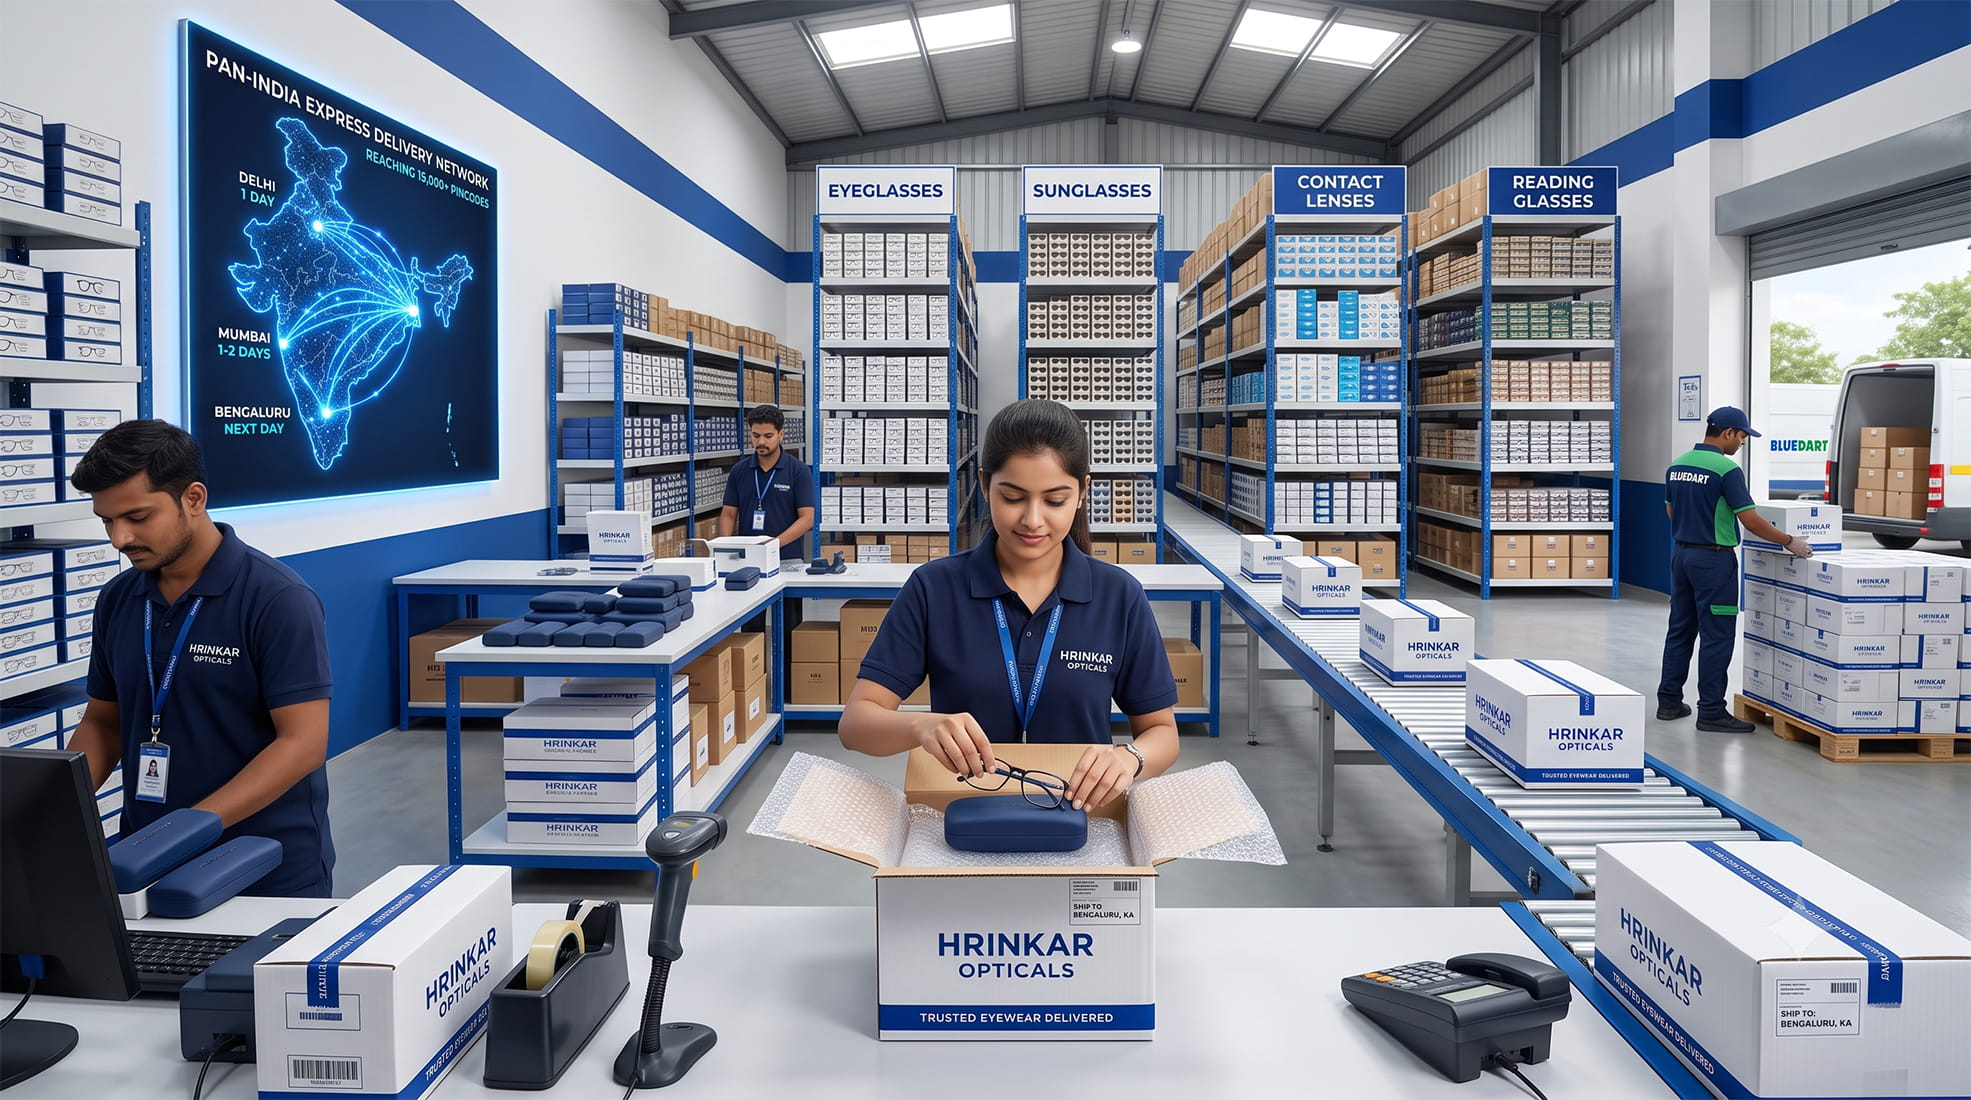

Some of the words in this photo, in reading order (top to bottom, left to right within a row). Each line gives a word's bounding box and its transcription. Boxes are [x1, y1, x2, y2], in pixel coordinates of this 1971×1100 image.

[206, 50, 301, 108] PAN-INDIA
[305, 95, 371, 138] EXPRESS
[374, 127, 433, 166] DELIVERY
[436, 155, 489, 191] NETWORK
[239, 171, 276, 192] DELHI
[366, 148, 415, 178] REACHING
[417, 170, 449, 192] 15,000+
[450, 184, 489, 209] PINCODES
[1297, 175, 1384, 190] CONTACT
[1513, 175, 1594, 190] READING
[240, 187, 247, 200] 1
[250, 190, 275, 207] DAY
[828, 183, 944, 198] EYEGLASSES
[1033, 183, 1152, 198] SUNGLASSES
[1306, 194, 1375, 208] LENSES
[1513, 194, 1594, 208] GLASSES
[218, 327, 271, 343] MUMBAI
[218, 344, 235, 356] 1-2
[238, 346, 271, 359] DAYS
[215, 406, 291, 418] BENGALURU
[224, 423, 257, 435] NEXT
[261, 423, 284, 434] DAY
[1770, 440, 1828, 452] BLUEDART
[1670, 471, 1709, 485] BLUEDART
[189, 643, 240, 658] HRINKAR
[1407, 642, 1459, 652] HRINKAR
[193, 655, 232, 665] OPTICALS
[1060, 650, 1113, 665] HRINKAR
[1067, 662, 1107, 673] OPTICALS
[1475, 694, 1511, 728] HRINKAR
[1480, 713, 1505, 735] OPTICALS
[1548, 728, 1624, 740] HRINKAR
[544, 740, 597, 748] HRINKAR
[1558, 743, 1614, 751] OPTICALS
[545, 782, 598, 791] HRINKAR
[546, 824, 599, 833] HRINKAR
[938, 932, 1094, 957] HRINKAR
[1620, 907, 1703, 996] HRINKAR
[426, 927, 497, 1010] HRINKAR
[958, 962, 1075, 979] OPTICALS
[1630, 944, 1690, 1006] OPTICALS
[439, 959, 490, 1018] OPTICALS
[920, 1013, 977, 1023] TRUSTED
[980, 1013, 1041, 1023] EYEWEAR
[1045, 1013, 1114, 1023] DELIVERED
[1612, 971, 1641, 1004] TRUSTED
[1674, 1031, 1715, 1075] DELIVERED
[1781, 1020, 1837, 1028] BENGALURU,
[425, 1045, 454, 1080] TRUSTED
